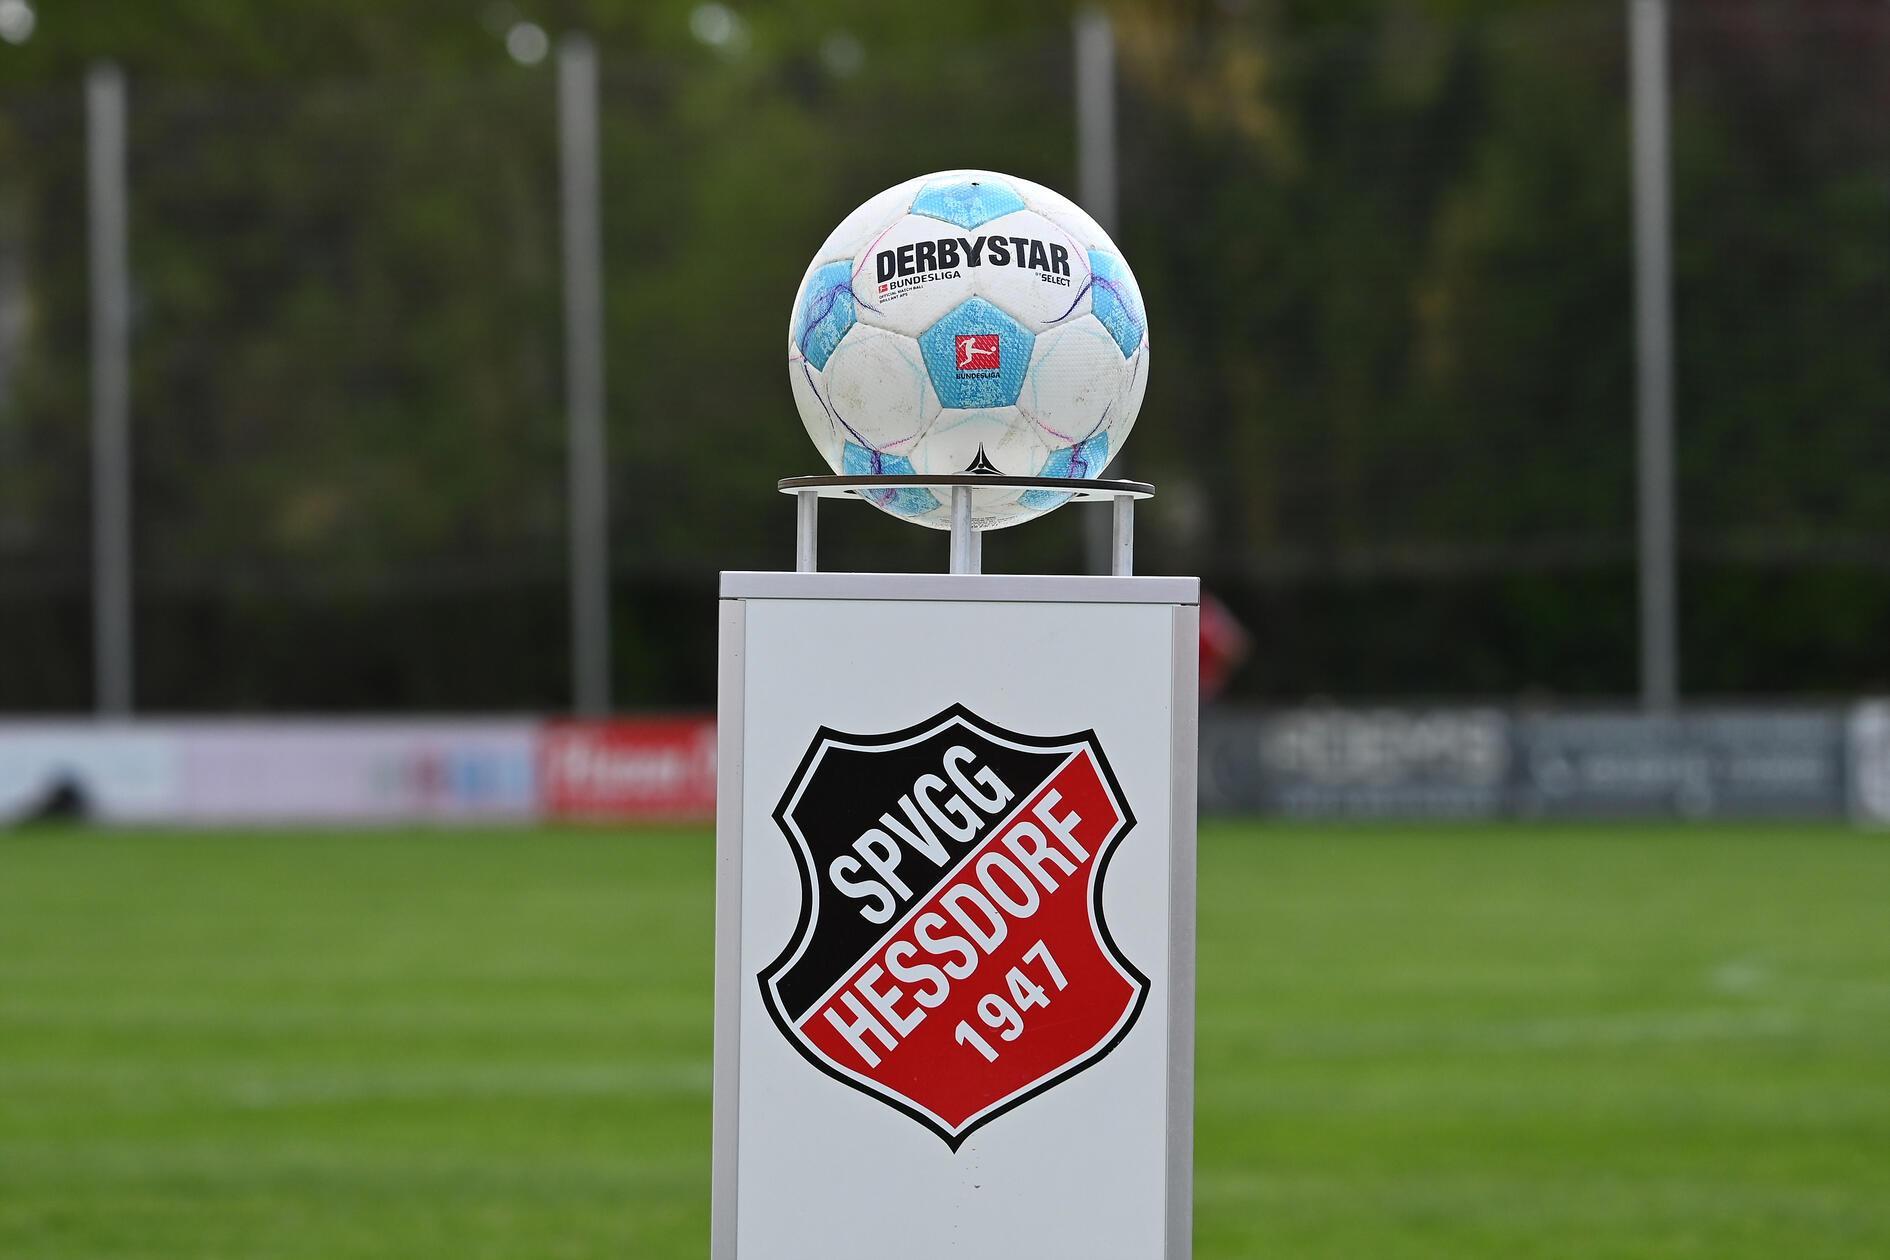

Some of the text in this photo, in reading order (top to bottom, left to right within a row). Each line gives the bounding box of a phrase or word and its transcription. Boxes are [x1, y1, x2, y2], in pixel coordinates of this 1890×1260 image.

[877, 236, 1070, 283] DERBYSTAR
[890, 271, 961, 290] BUNDESLIGA
[1041, 273, 1070, 287] SELECT
[956, 372, 1000, 380] BUNDESLIGA
[829, 745, 1015, 924] SPVGG
[823, 788, 1090, 1069] HESSDORF
[955, 939, 1069, 1063] 1947
